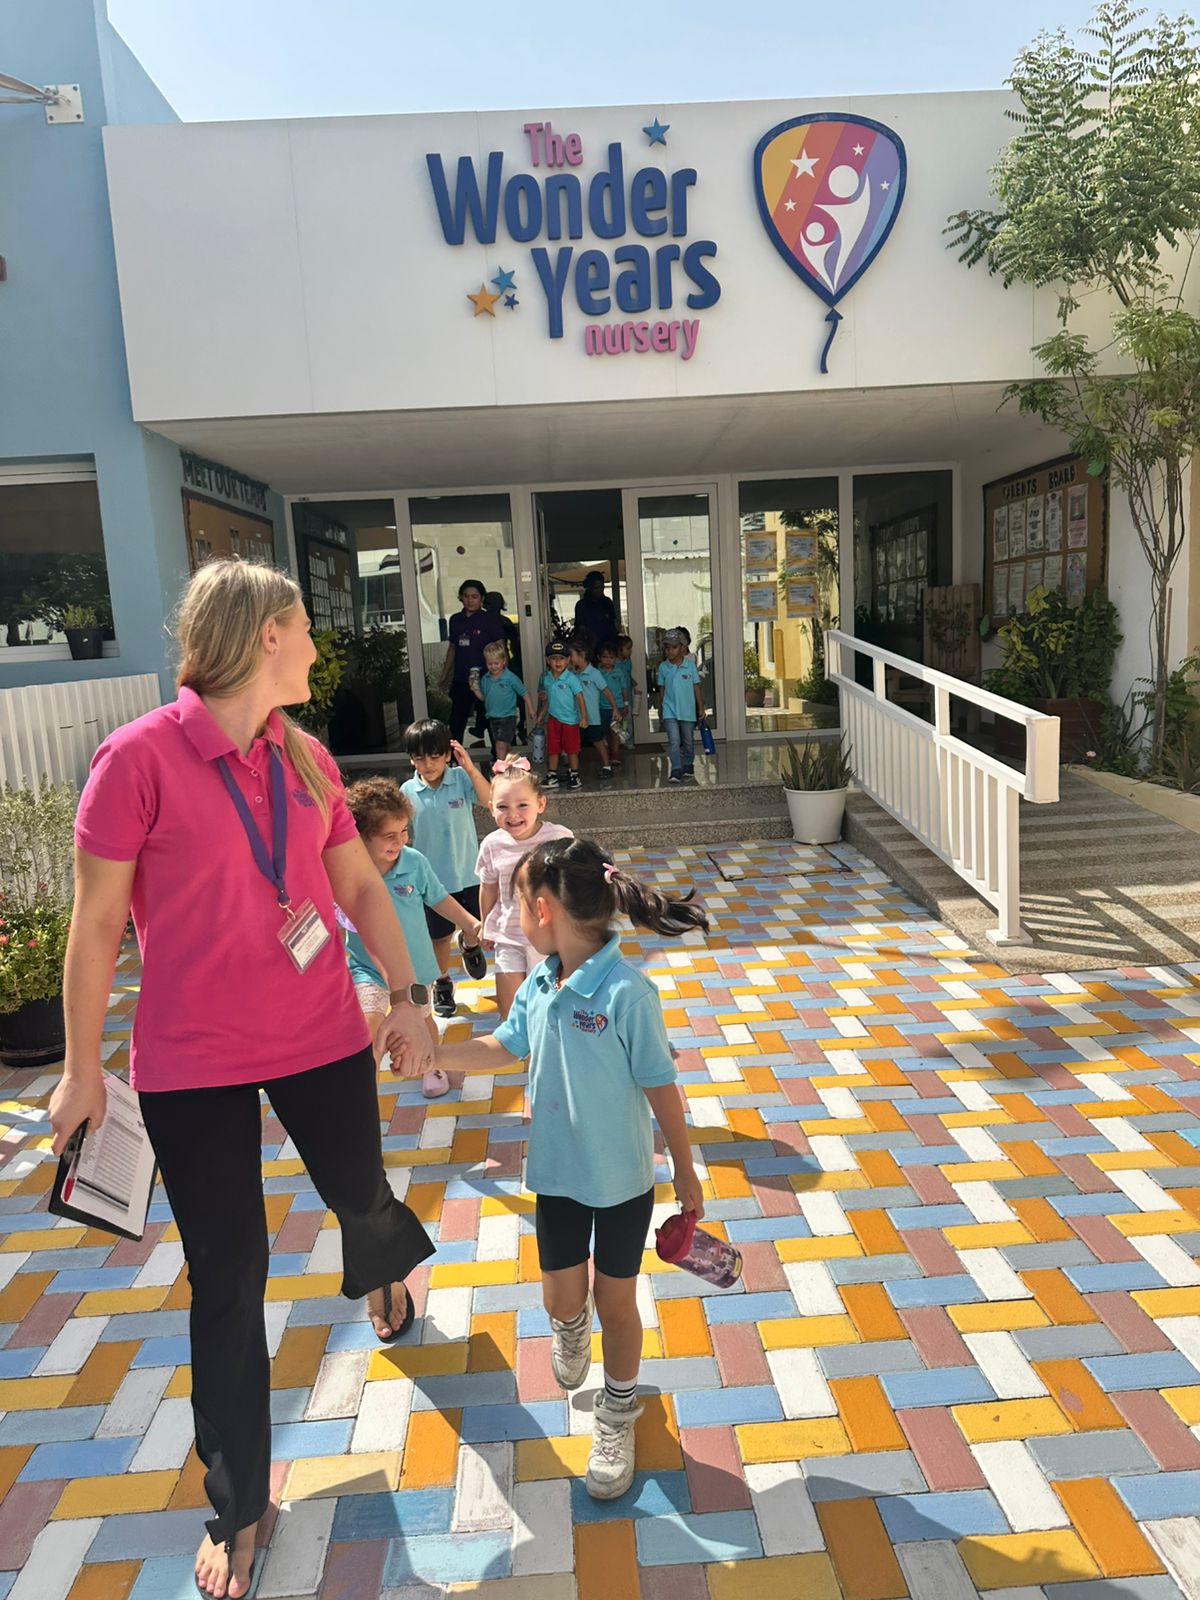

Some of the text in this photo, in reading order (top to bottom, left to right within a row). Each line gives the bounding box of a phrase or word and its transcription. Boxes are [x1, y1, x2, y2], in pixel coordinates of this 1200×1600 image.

[524, 122, 583, 167] The
[426, 142, 697, 246] Wonder
[531, 240, 721, 338] Years
[585, 319, 699, 360] nursery
